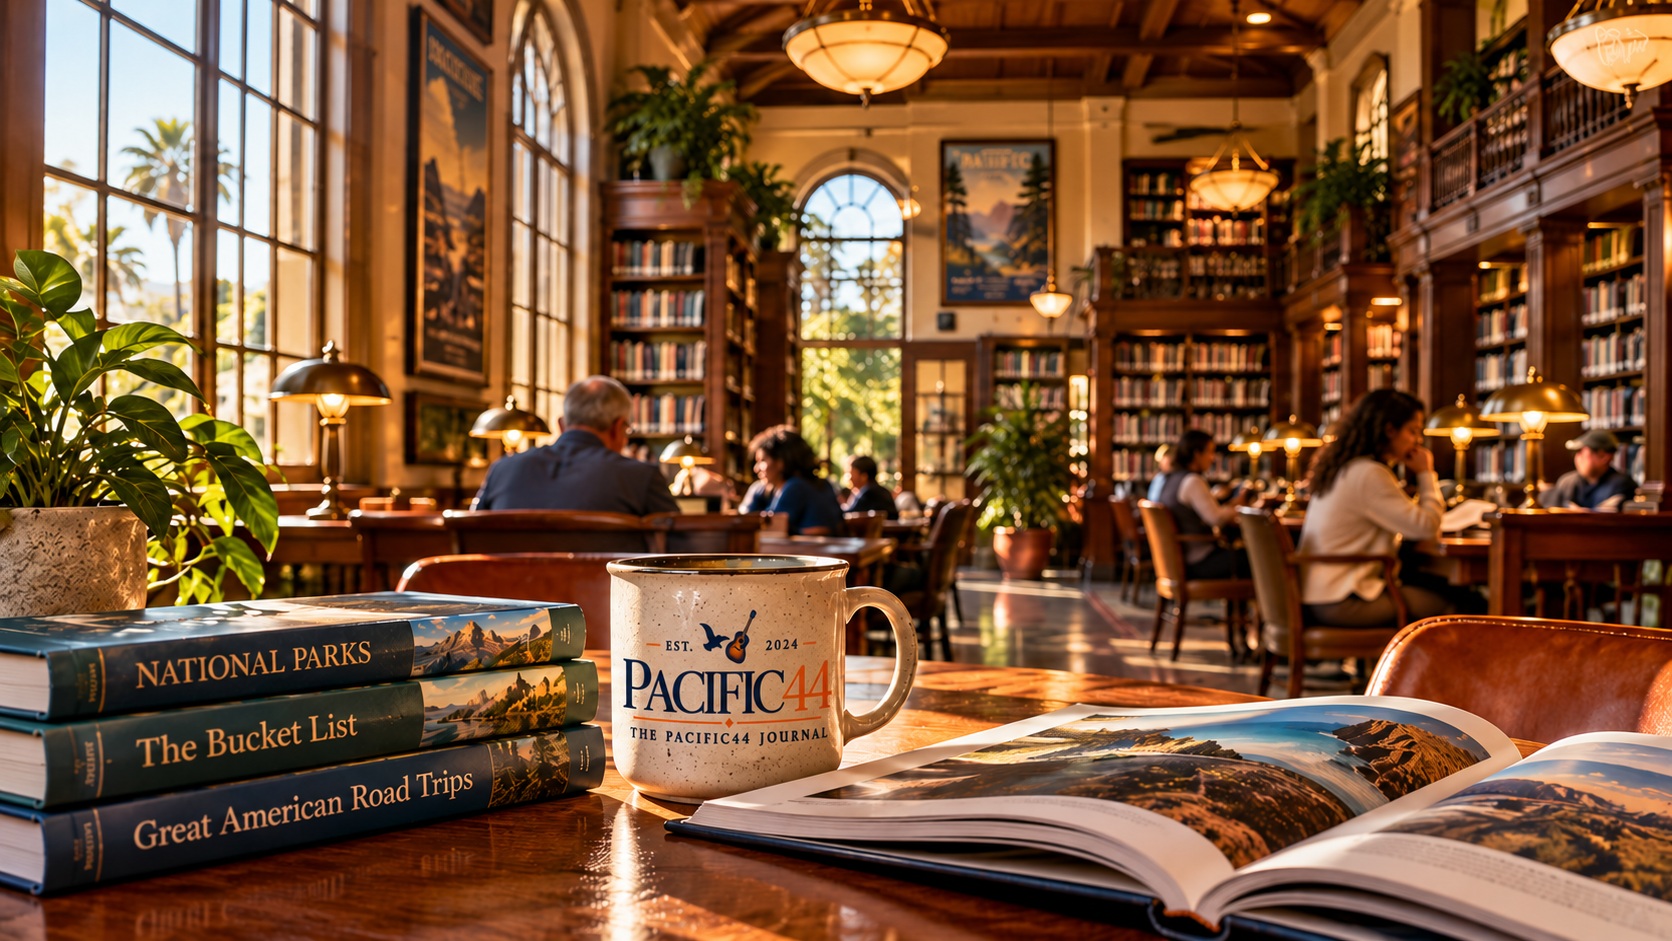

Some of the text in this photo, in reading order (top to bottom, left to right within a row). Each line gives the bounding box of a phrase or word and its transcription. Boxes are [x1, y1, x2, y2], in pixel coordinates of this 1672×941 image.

[135, 649, 286, 689] NATIONAL
[292, 640, 373, 672] PARKS
[665, 638, 799, 652] EST. 2024
[623, 658, 832, 714] PACIFIC44
[135, 733, 198, 769] The
[206, 720, 302, 758] Bucket
[309, 713, 358, 743] List
[630, 726, 829, 747] THE PACIFIC44 JOURNAL
[133, 812, 213, 851] Great
[220, 794, 343, 834] American
[350, 772, 411, 811] Road
[416, 766, 474, 804] Trips
